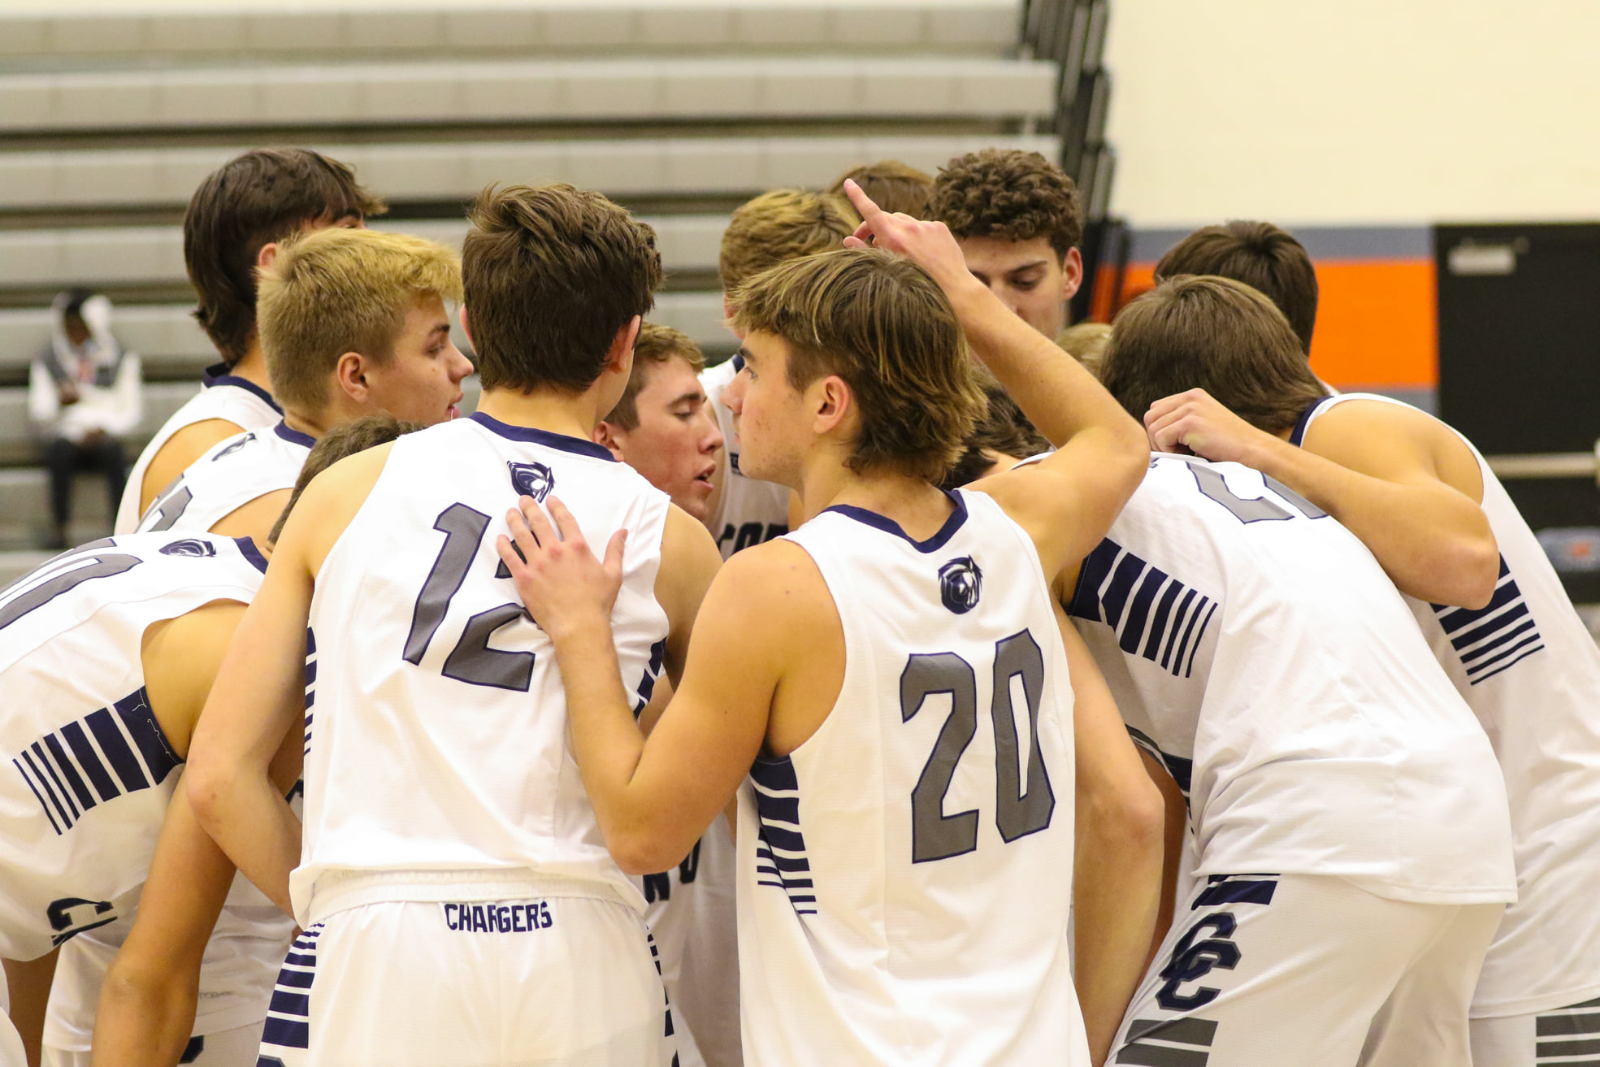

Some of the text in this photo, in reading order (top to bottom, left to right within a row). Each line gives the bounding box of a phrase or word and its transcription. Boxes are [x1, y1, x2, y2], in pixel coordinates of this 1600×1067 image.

[402, 501, 544, 692] 12
[900, 628, 1055, 864] 20
[444, 901, 553, 933] CHARGERS
